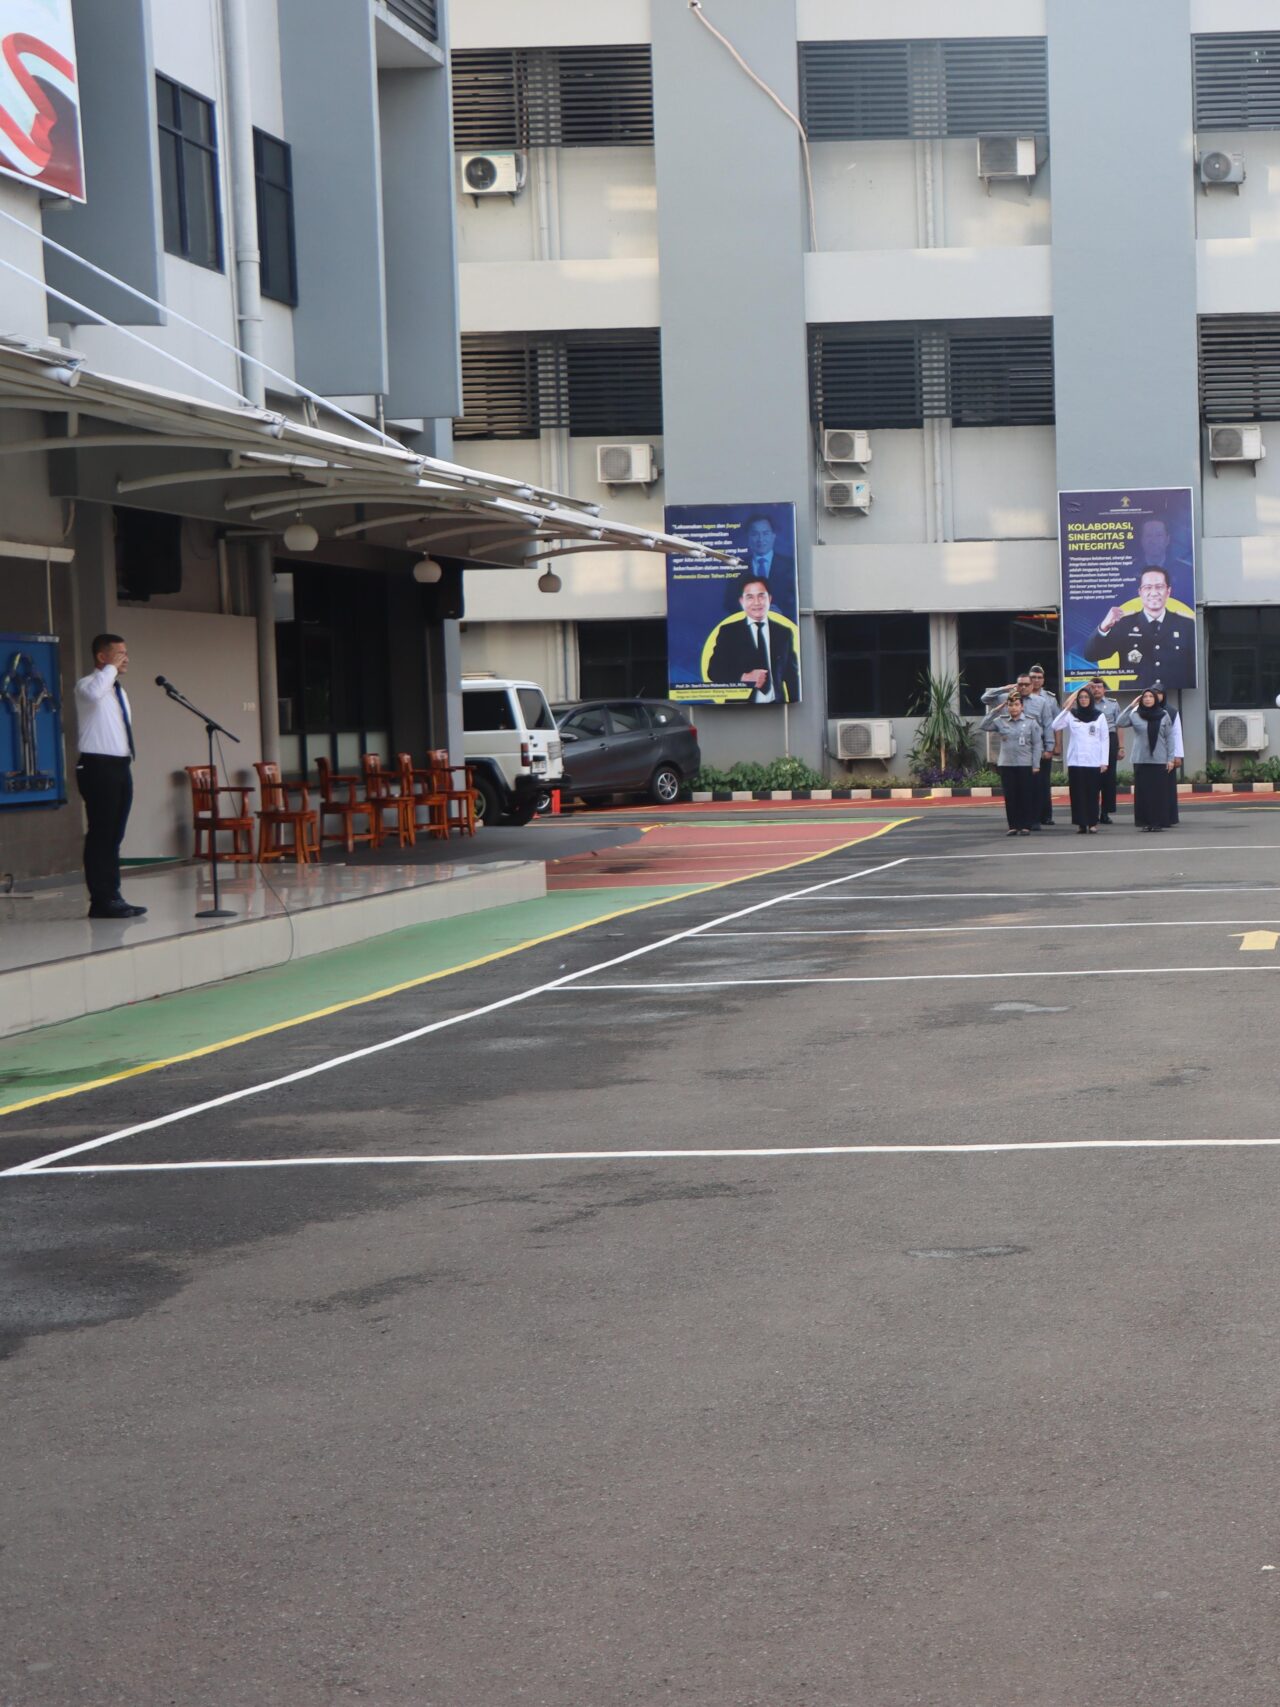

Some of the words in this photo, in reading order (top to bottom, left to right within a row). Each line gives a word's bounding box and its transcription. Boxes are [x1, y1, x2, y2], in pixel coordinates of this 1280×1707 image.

[1068, 522, 1134, 531] KOLABORASI,
[1068, 532, 1125, 541] SINERGITAS
[1127, 532, 1134, 540] &
[1069, 542, 1126, 551] INTEGRITAS
